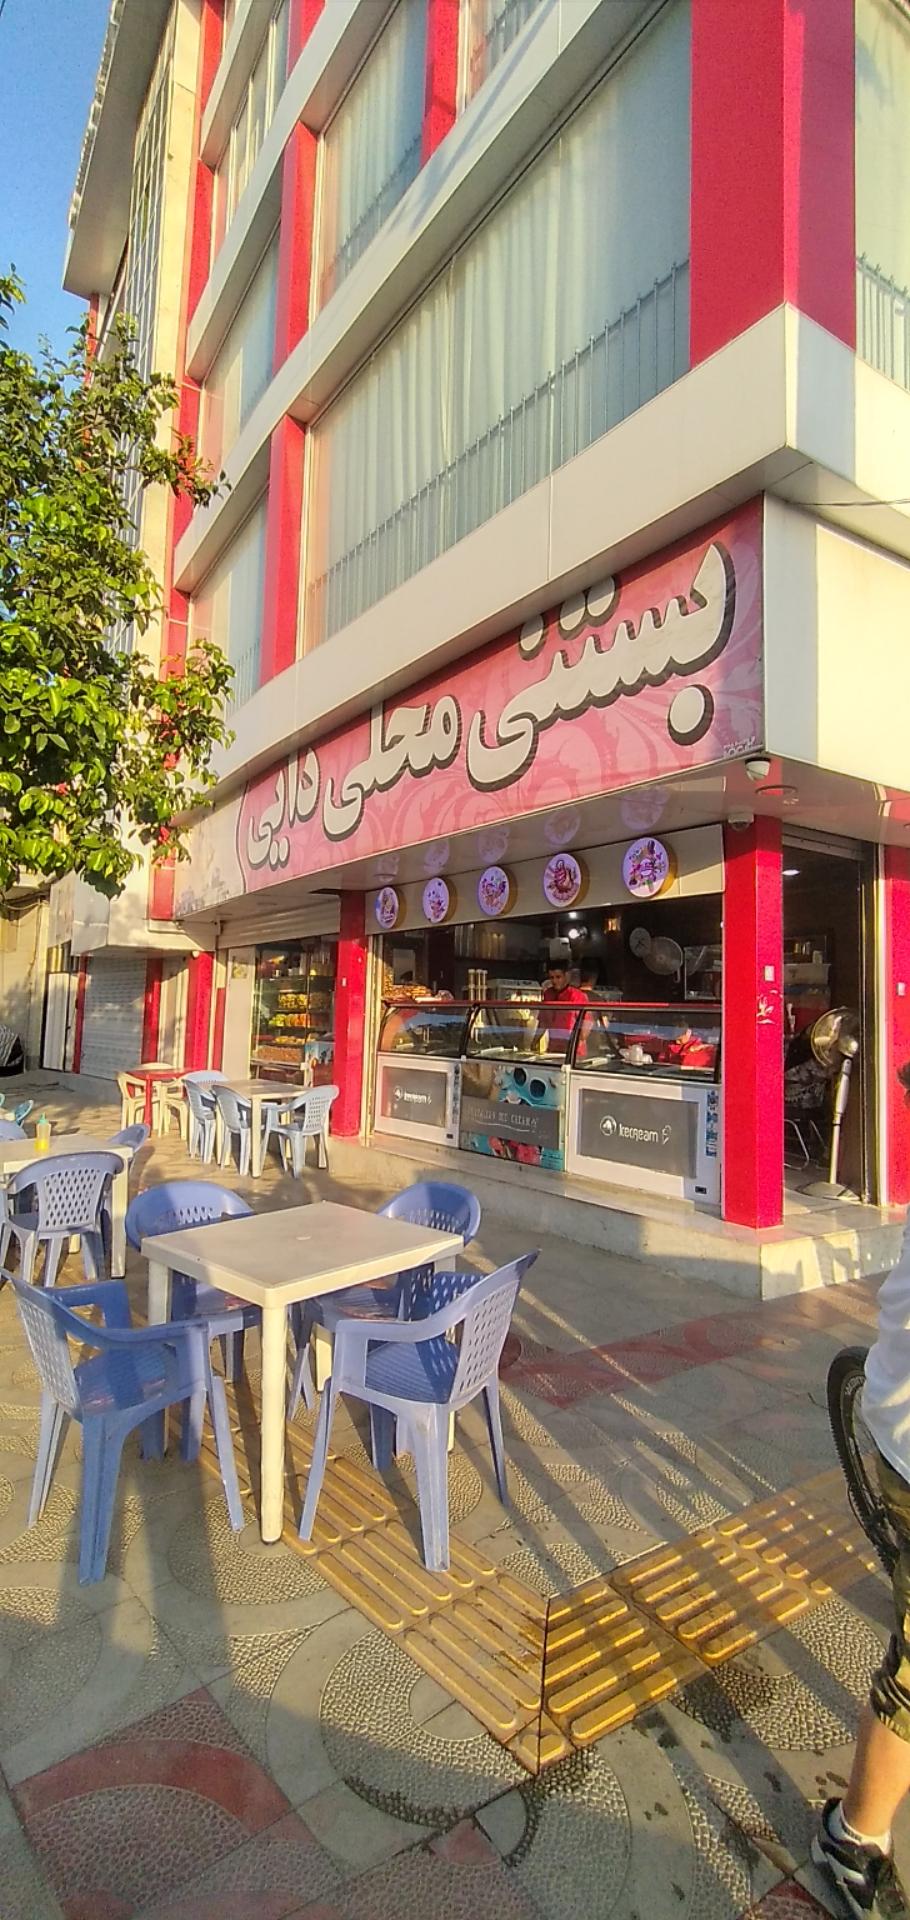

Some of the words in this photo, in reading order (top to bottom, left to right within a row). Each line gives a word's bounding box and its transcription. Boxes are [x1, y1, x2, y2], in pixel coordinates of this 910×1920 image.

[466, 541, 735, 792] بستنی
[247, 746, 321, 871] دایی
[323, 694, 461, 841] محلی
